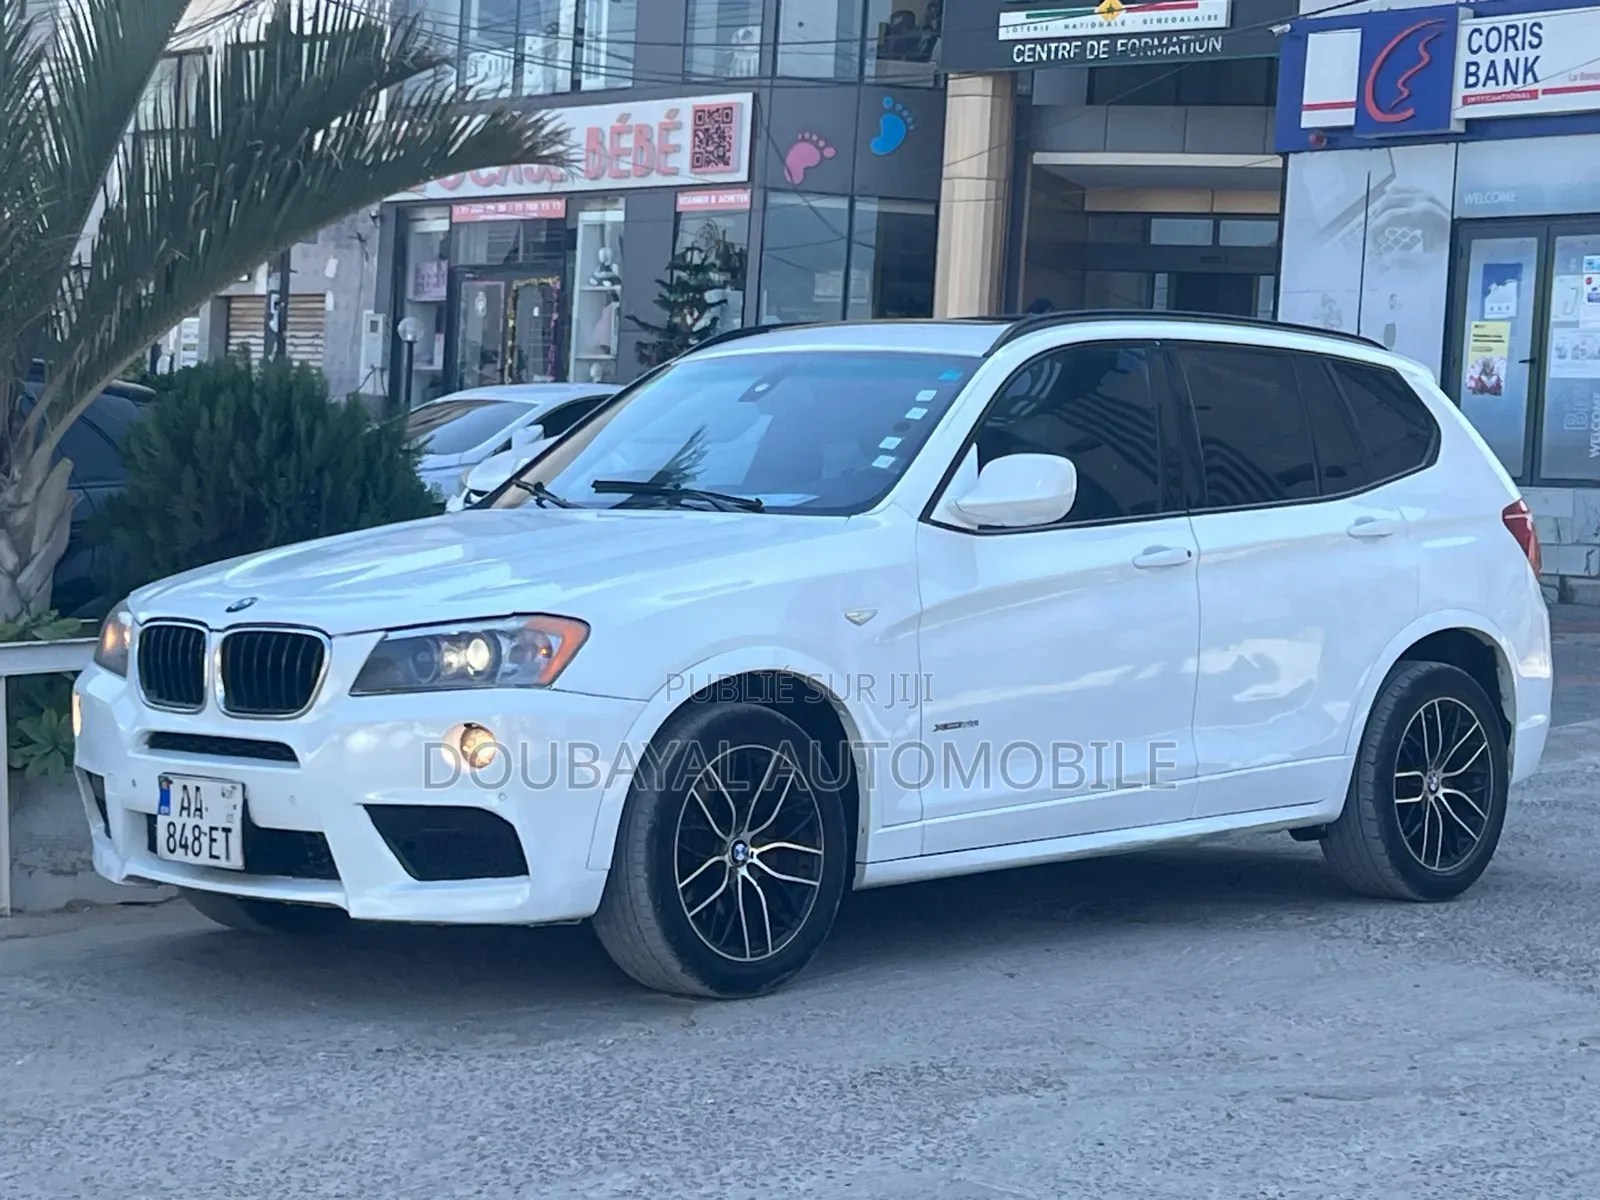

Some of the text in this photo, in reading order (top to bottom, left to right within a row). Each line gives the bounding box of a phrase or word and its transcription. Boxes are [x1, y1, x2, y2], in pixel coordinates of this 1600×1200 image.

[1005, 24, 1050, 35] LOTERIE
[1063, 20, 1126, 31] NATIONALE
[1467, 21, 1544, 55] CORIS
[1013, 34, 1223, 63] CENTRE DE FORMATION
[1463, 55, 1541, 89] BANK
[584, 108, 683, 180] BÉBÉ
[1464, 190, 1518, 205] WELCOME
[178, 784, 204, 820] AA
